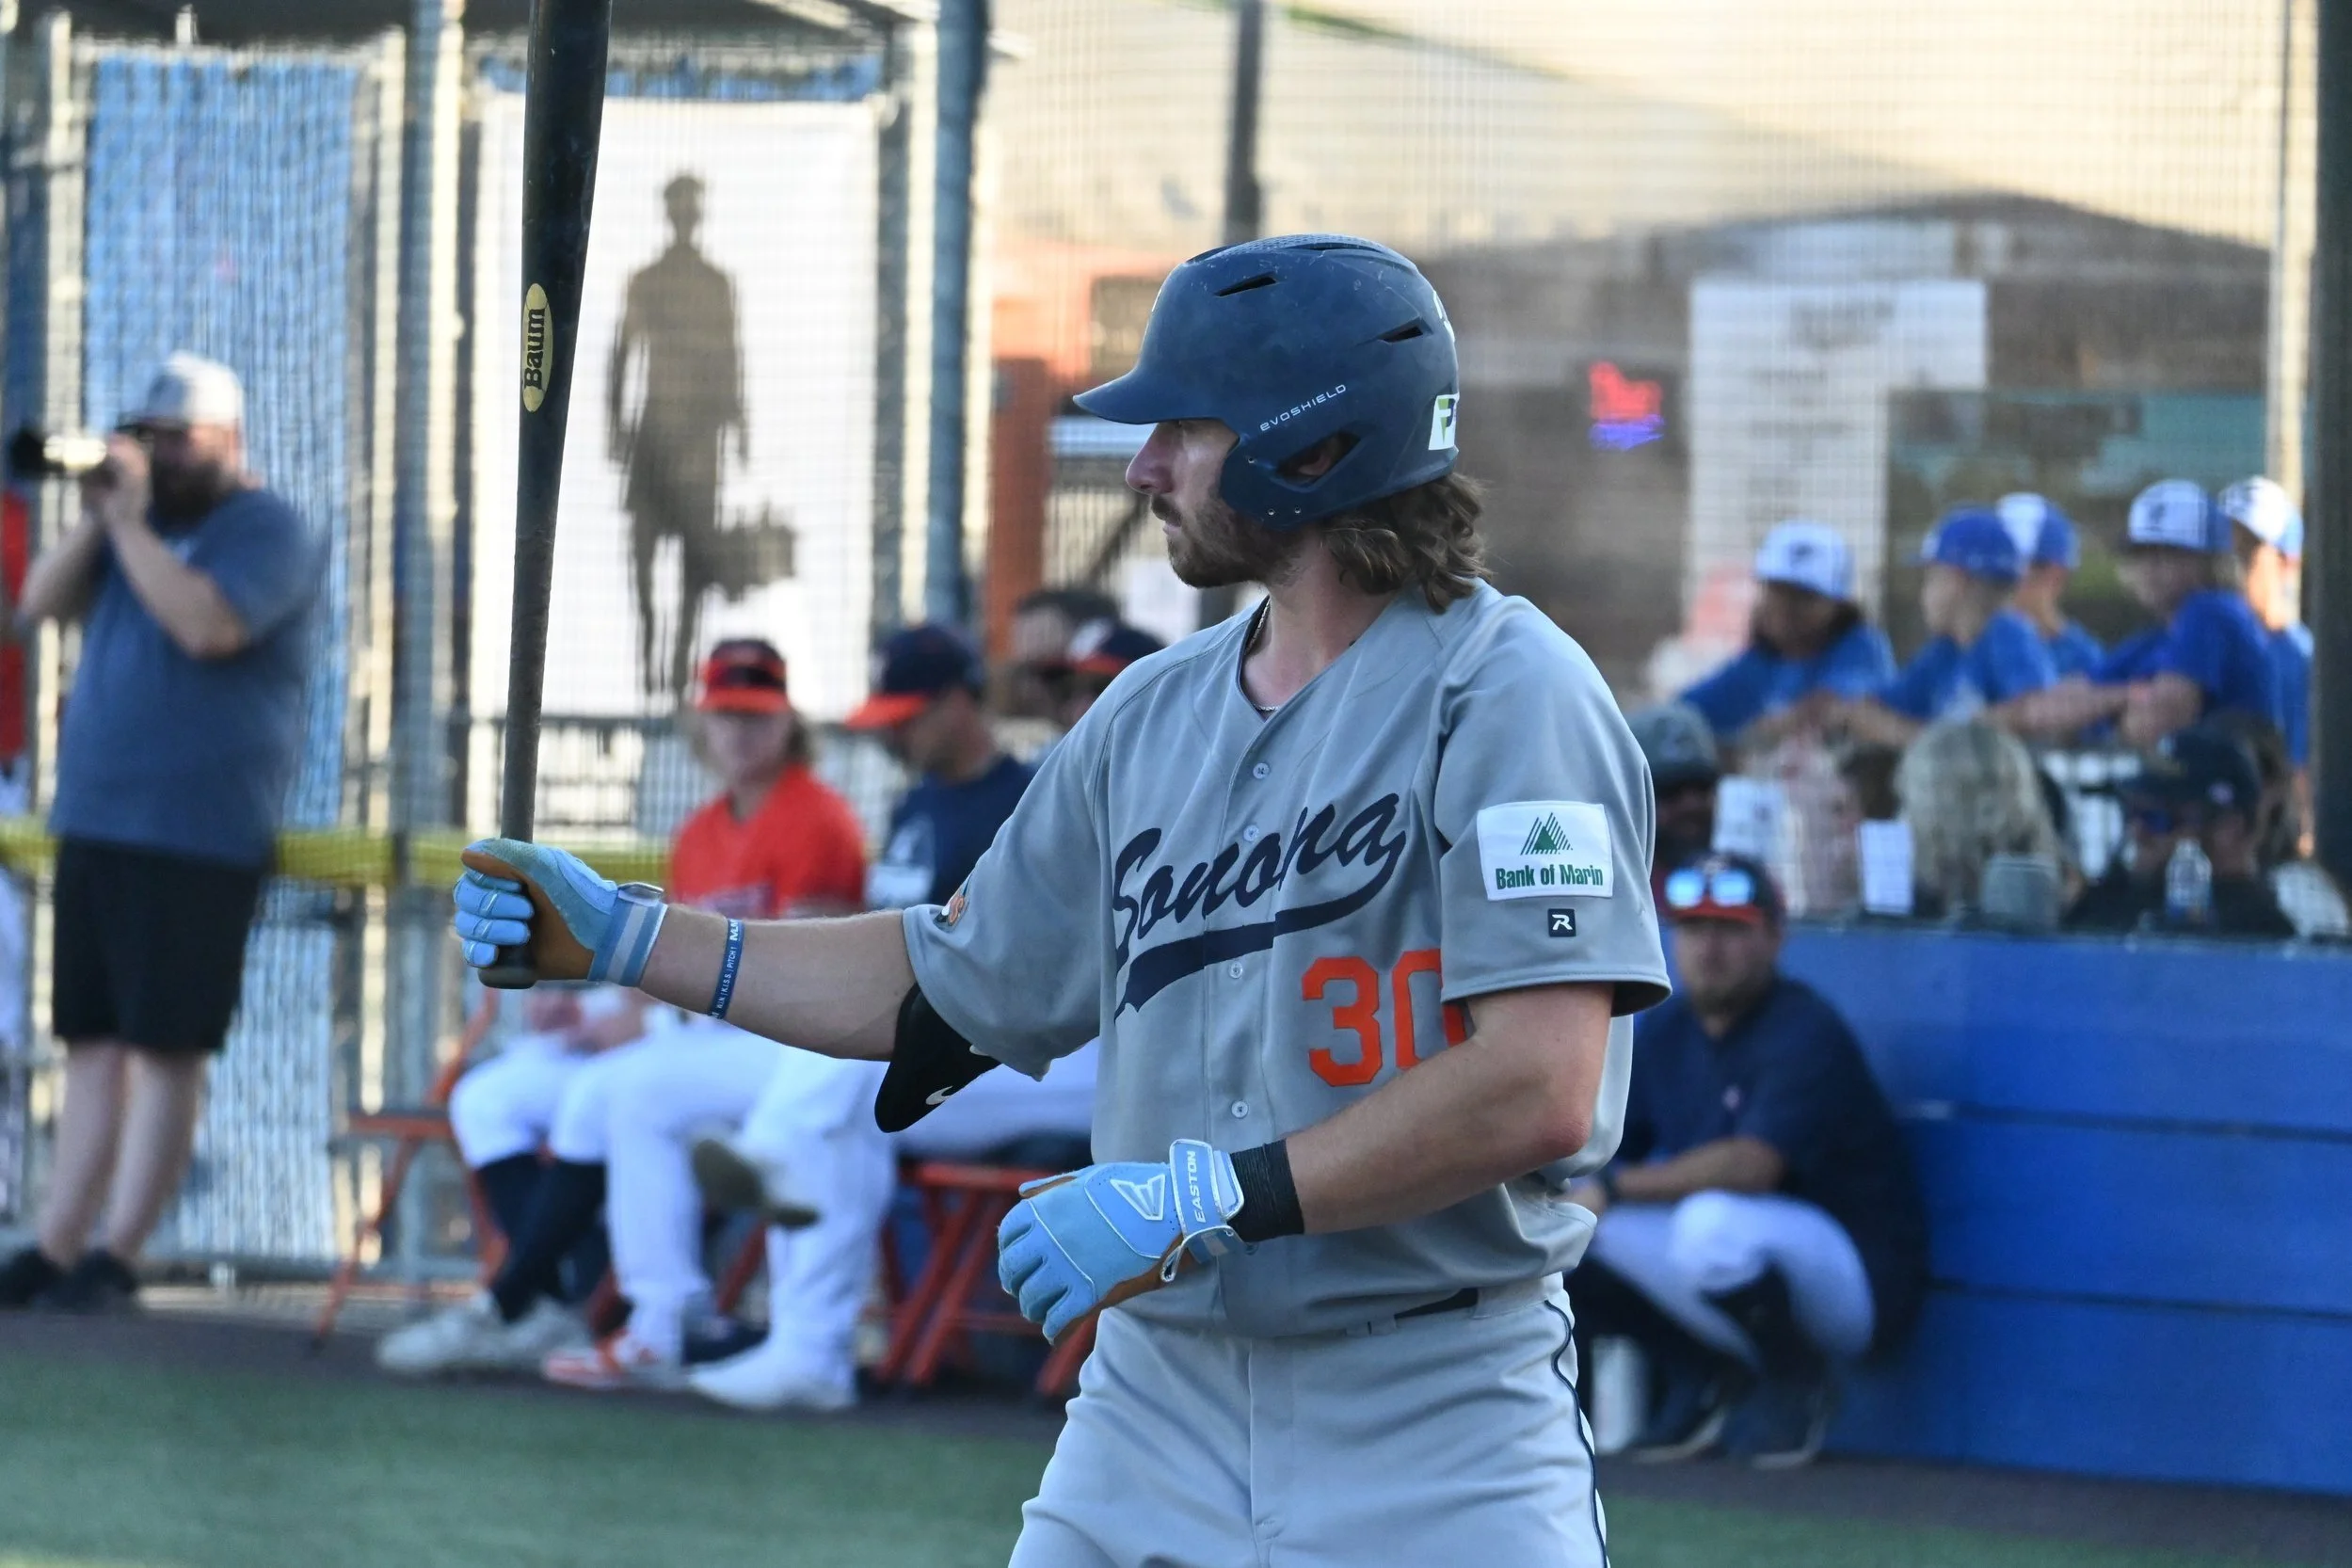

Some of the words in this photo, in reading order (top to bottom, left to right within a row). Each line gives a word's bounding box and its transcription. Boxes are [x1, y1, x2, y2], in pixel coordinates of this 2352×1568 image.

[524, 309, 545, 390] Baum
[1496, 865, 1535, 889] Bank
[1540, 864, 1555, 885] of
[1559, 864, 1603, 886] Marin
[1552, 914, 1573, 930] R
[727, 951, 736, 969] PITCH
[1303, 948, 1465, 1086] 30
[1187, 1150, 1206, 1223] EASTON
